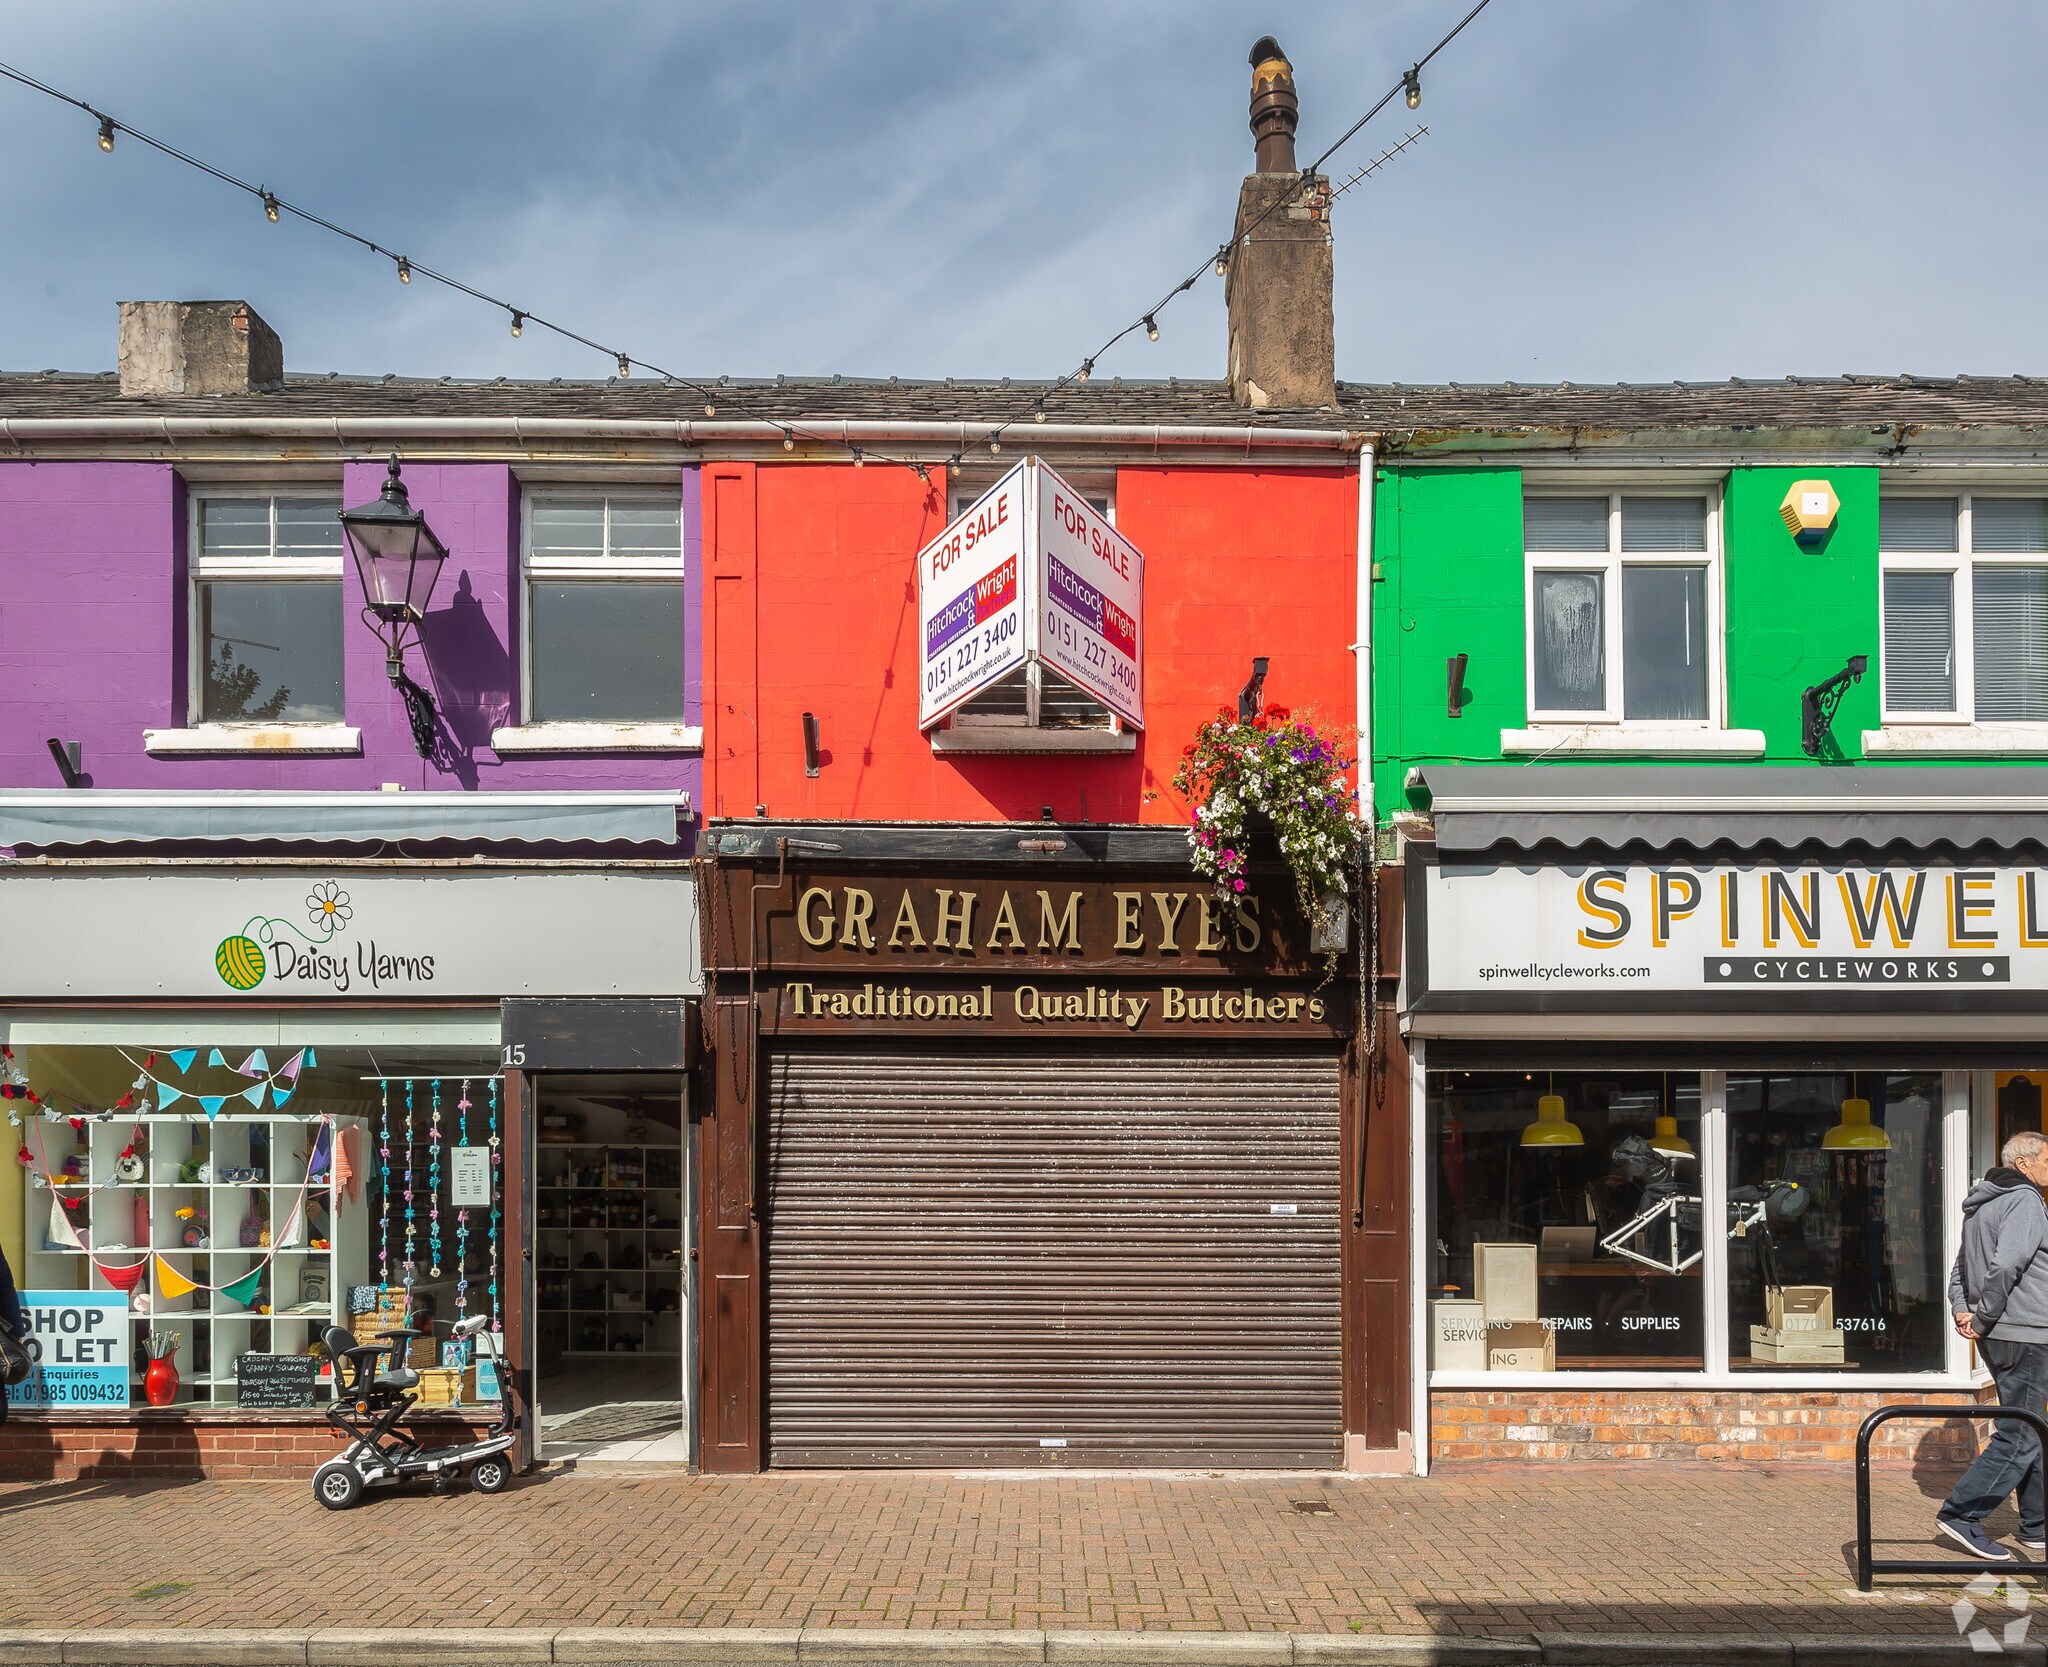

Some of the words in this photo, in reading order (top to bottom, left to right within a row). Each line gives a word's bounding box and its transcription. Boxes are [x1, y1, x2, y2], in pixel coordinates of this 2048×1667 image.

[931, 534, 961, 580] FOR
[966, 493, 1008, 551] SALE
[1054, 492, 1088, 545] FOR
[1092, 527, 1130, 582] SALE
[928, 589, 975, 642] Hitchcock
[976, 561, 1015, 602] Wright
[967, 609, 976, 629] &
[976, 585, 1015, 621] Partners
[1049, 557, 1103, 616] Hitchcock
[1104, 599, 1135, 641] Wright
[927, 656, 951, 693] 0151
[957, 636, 979, 672] 227
[984, 611, 1017, 654] 3400
[1047, 610, 1077, 652] 0151
[1084, 636, 1106, 669] 227
[1111, 654, 1136, 693] 3400
[934, 645, 1012, 705] www.hitchcockwright.co.uk
[1056, 649, 1133, 708] www.hitchcockwright.co.uk
[797, 886, 1084, 950] GRAHAM
[1112, 891, 1261, 953] EYES
[268, 941, 350, 992] Daisy
[356, 939, 435, 989] Yarns
[1479, 963, 1651, 981] spinwellcycleworks.com
[1753, 961, 1958, 979] CYCLEWORKS
[786, 983, 993, 1017] Traditional
[1014, 985, 1149, 1027] Quality
[1161, 987, 1325, 1020] Butchers
[502, 1043, 526, 1065] 15
[20, 1308, 104, 1334] SHOP
[1441, 1317, 1513, 1330] SERVICING
[1541, 1317, 1593, 1330] REPAIRS
[1621, 1317, 1680, 1330] SUPPLIES
[1785, 1318, 1827, 1331] 01704
[1835, 1318, 1886, 1331] 537616
[56, 1338, 118, 1363] LET
[40, 1369, 99, 1381] Enquiries
[71, 1383, 125, 1401] 009432
